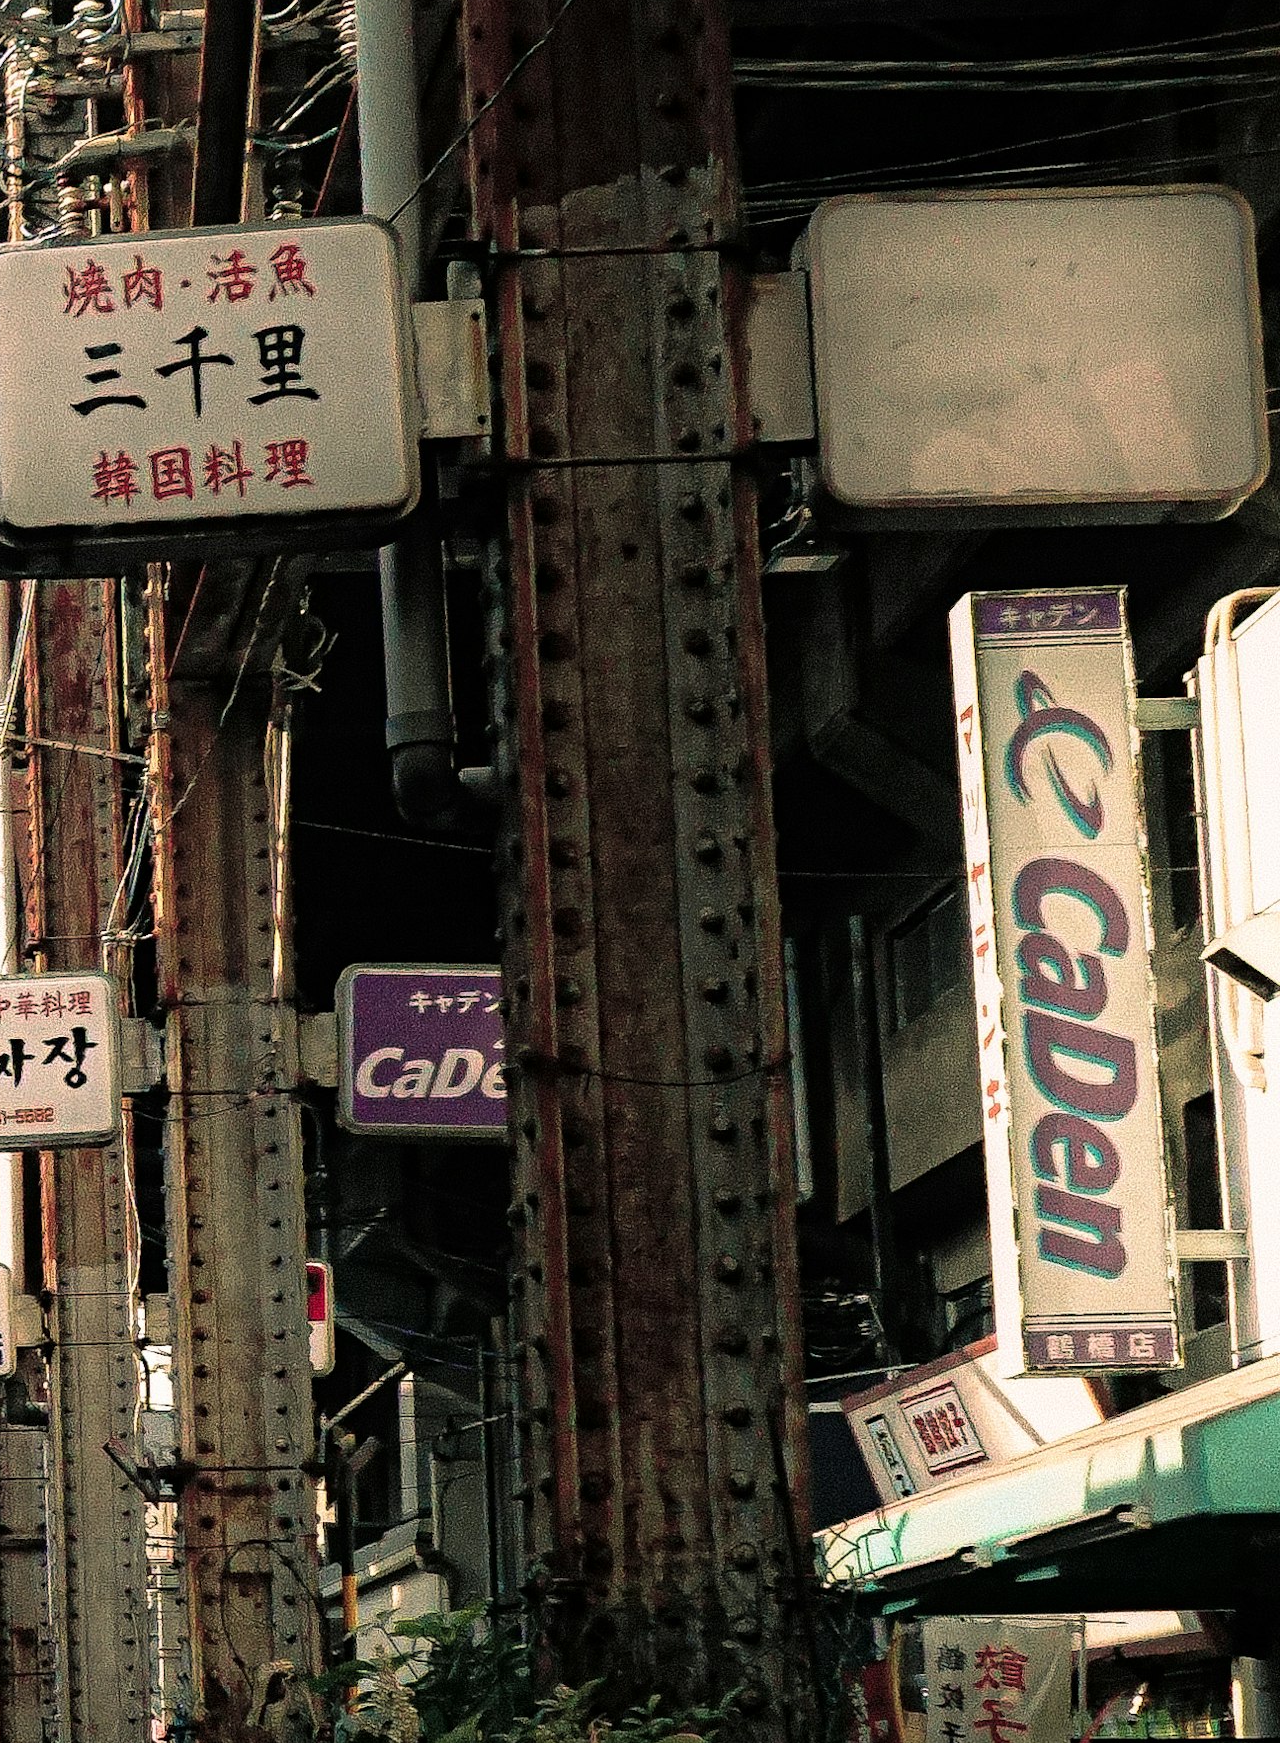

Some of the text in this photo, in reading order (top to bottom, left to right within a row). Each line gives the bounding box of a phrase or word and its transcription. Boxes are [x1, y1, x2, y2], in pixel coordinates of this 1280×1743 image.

[70, 324, 321, 419] 三千里
[91, 439, 314, 508] 韓国料理
[999, 603, 1098, 630] キャデン
[355, 1046, 508, 1100] CaDe
[1012, 858, 1138, 1281] CaDen
